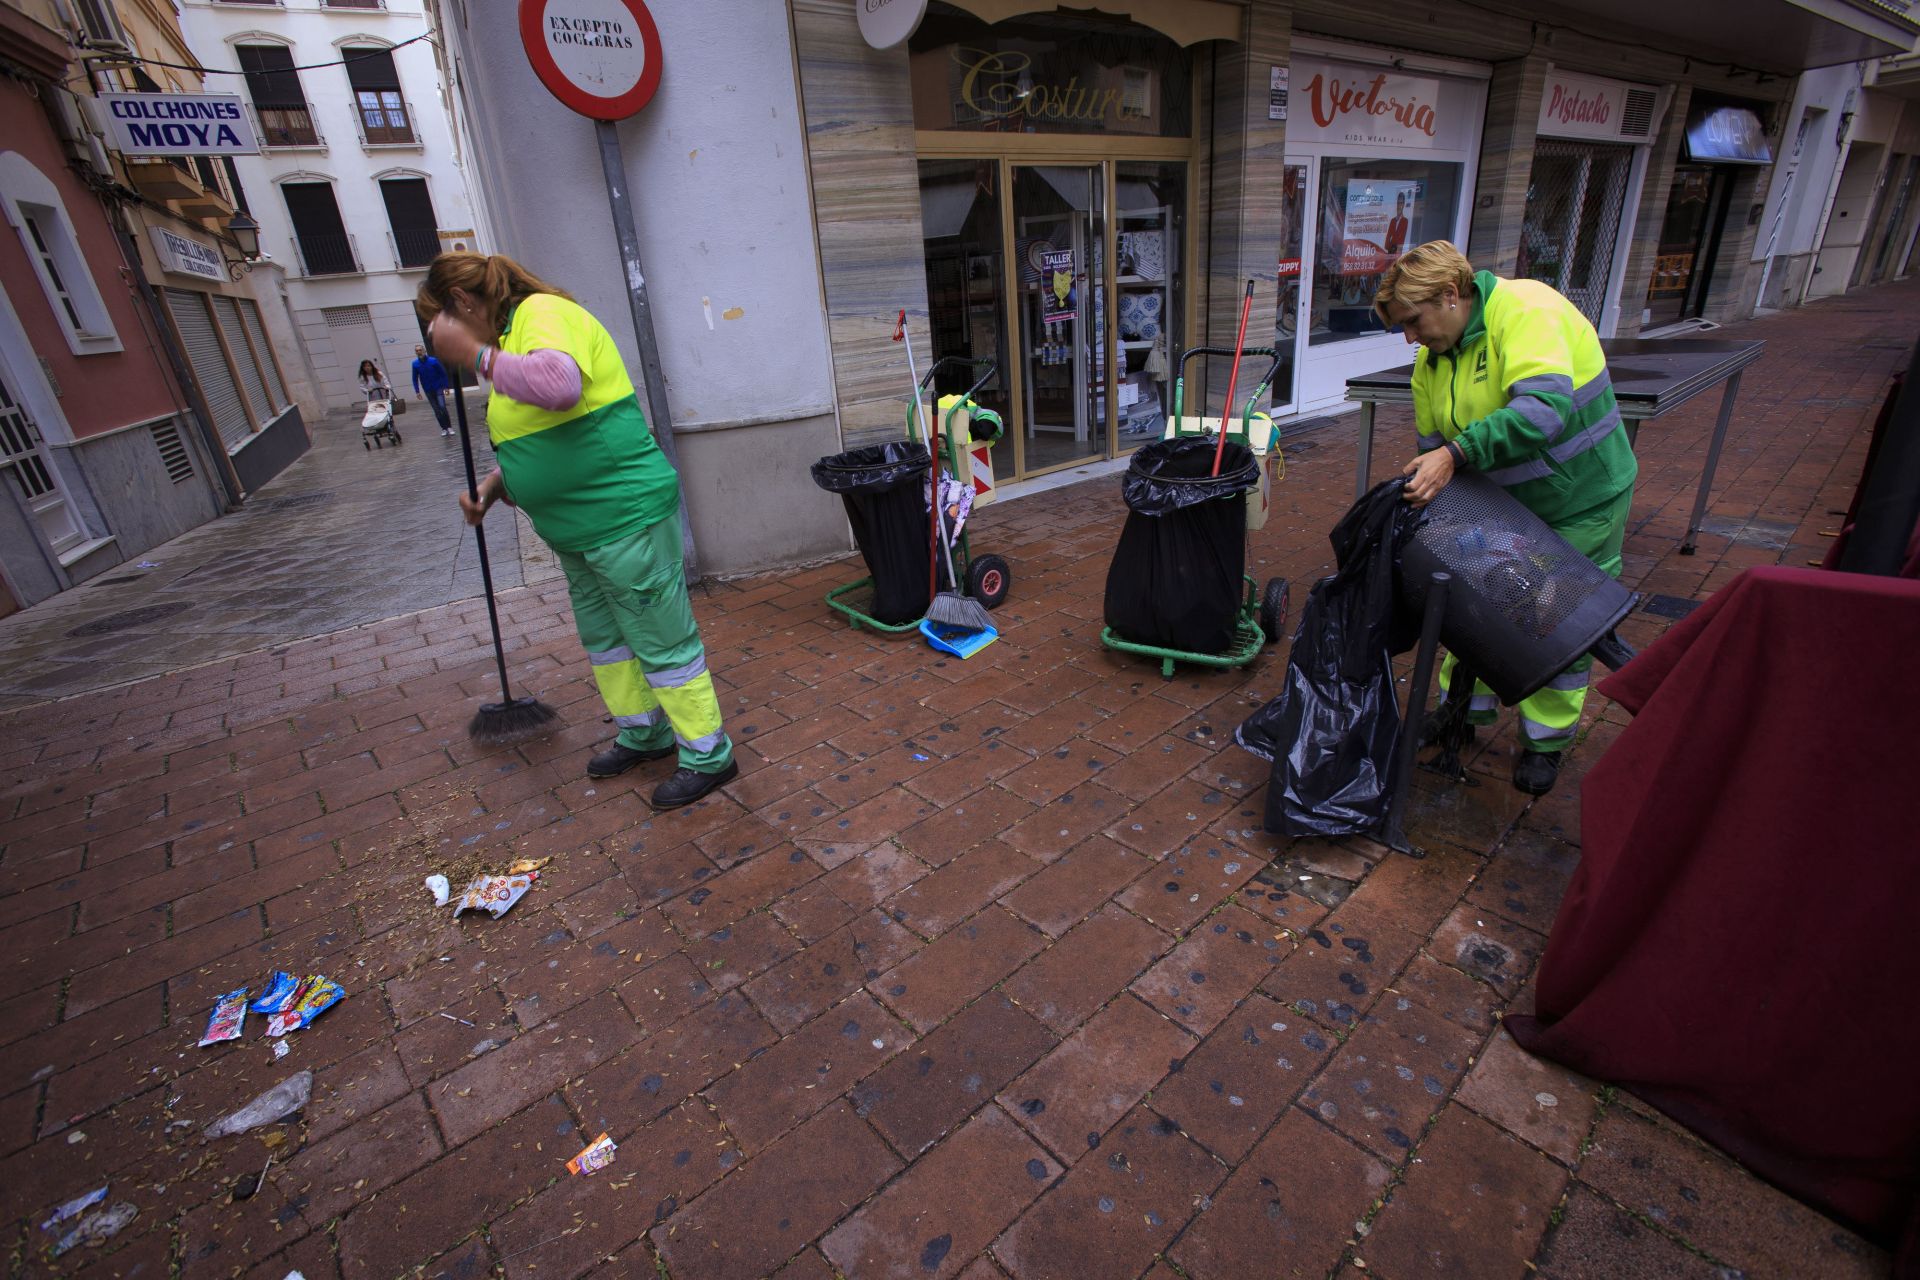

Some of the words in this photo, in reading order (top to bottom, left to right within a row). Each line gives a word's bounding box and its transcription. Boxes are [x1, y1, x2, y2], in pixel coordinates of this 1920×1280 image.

[550, 16, 622, 34] EXCEPTO
[952, 47, 1142, 122] Costura
[110, 100, 241, 120] COLCHONES
[1301, 73, 1437, 136] Victoria
[1547, 84, 1610, 125] Pistacho
[126, 123, 243, 147] MOYA
[162, 231, 206, 262] TRESILLOS
[1344, 243, 1376, 260] Alquilo
[1045, 254, 1071, 266] TALLER
[1278, 262, 1299, 273] ZIPPY
